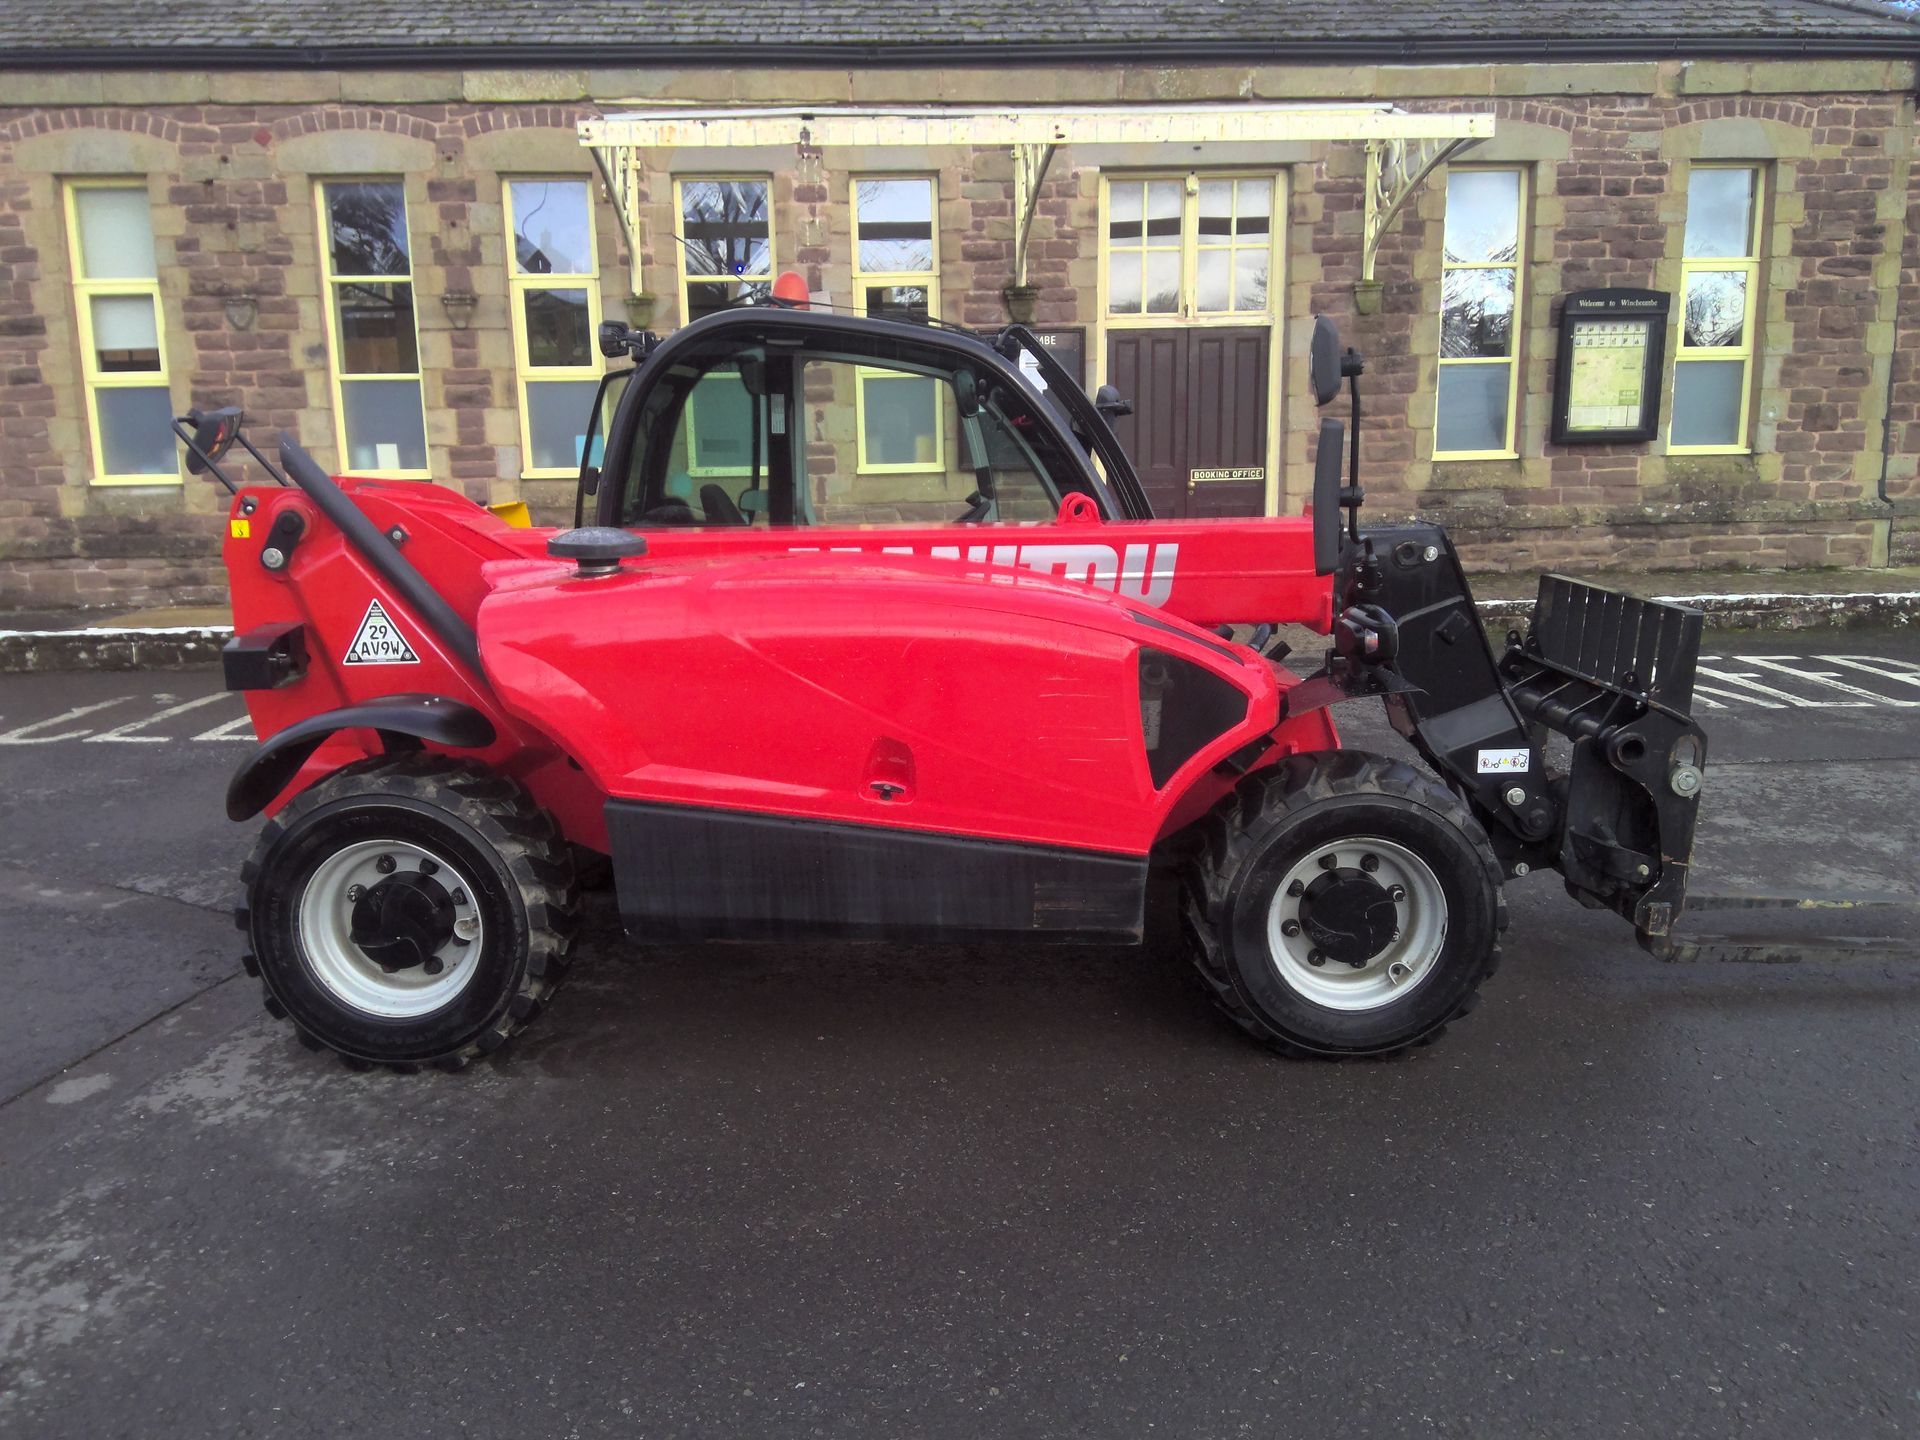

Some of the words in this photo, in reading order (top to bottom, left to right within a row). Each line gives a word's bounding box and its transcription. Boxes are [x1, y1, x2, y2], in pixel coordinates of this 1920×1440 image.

[1579, 299, 1605, 307] Welcome
[1194, 471, 1230, 479] BOOKING
[1232, 470, 1261, 478] OFFICE
[369, 625, 388, 640] 29
[361, 641, 400, 656] AV9W
